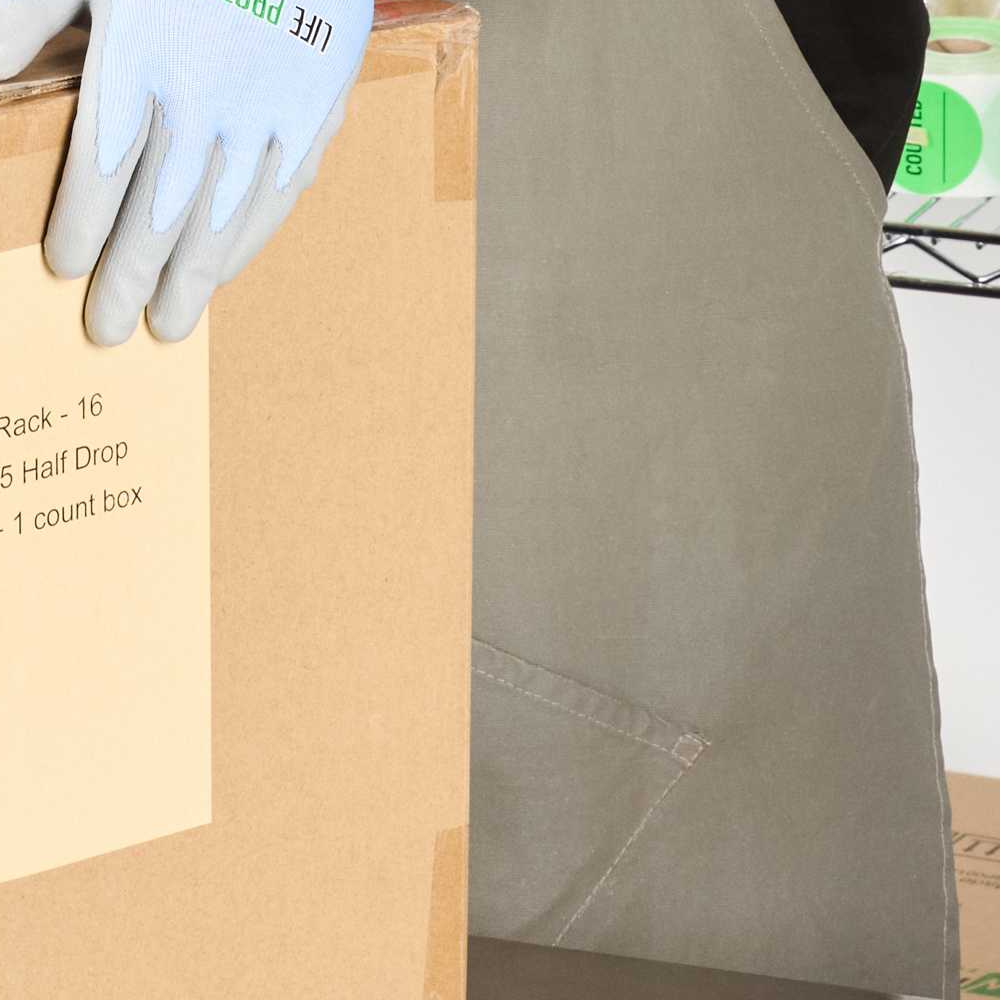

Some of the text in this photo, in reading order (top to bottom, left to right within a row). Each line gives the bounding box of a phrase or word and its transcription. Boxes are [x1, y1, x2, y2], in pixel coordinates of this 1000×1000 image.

[289, 5, 333, 52] LIFE
[78, 393, 102, 420] 16
[1, 465, 13, 489] 5
[23, 450, 68, 484] Half
[76, 442, 127, 471] Drop
[14, 512, 21, 535] 1
[35, 494, 95, 529] count
[104, 487, 142, 512] box
